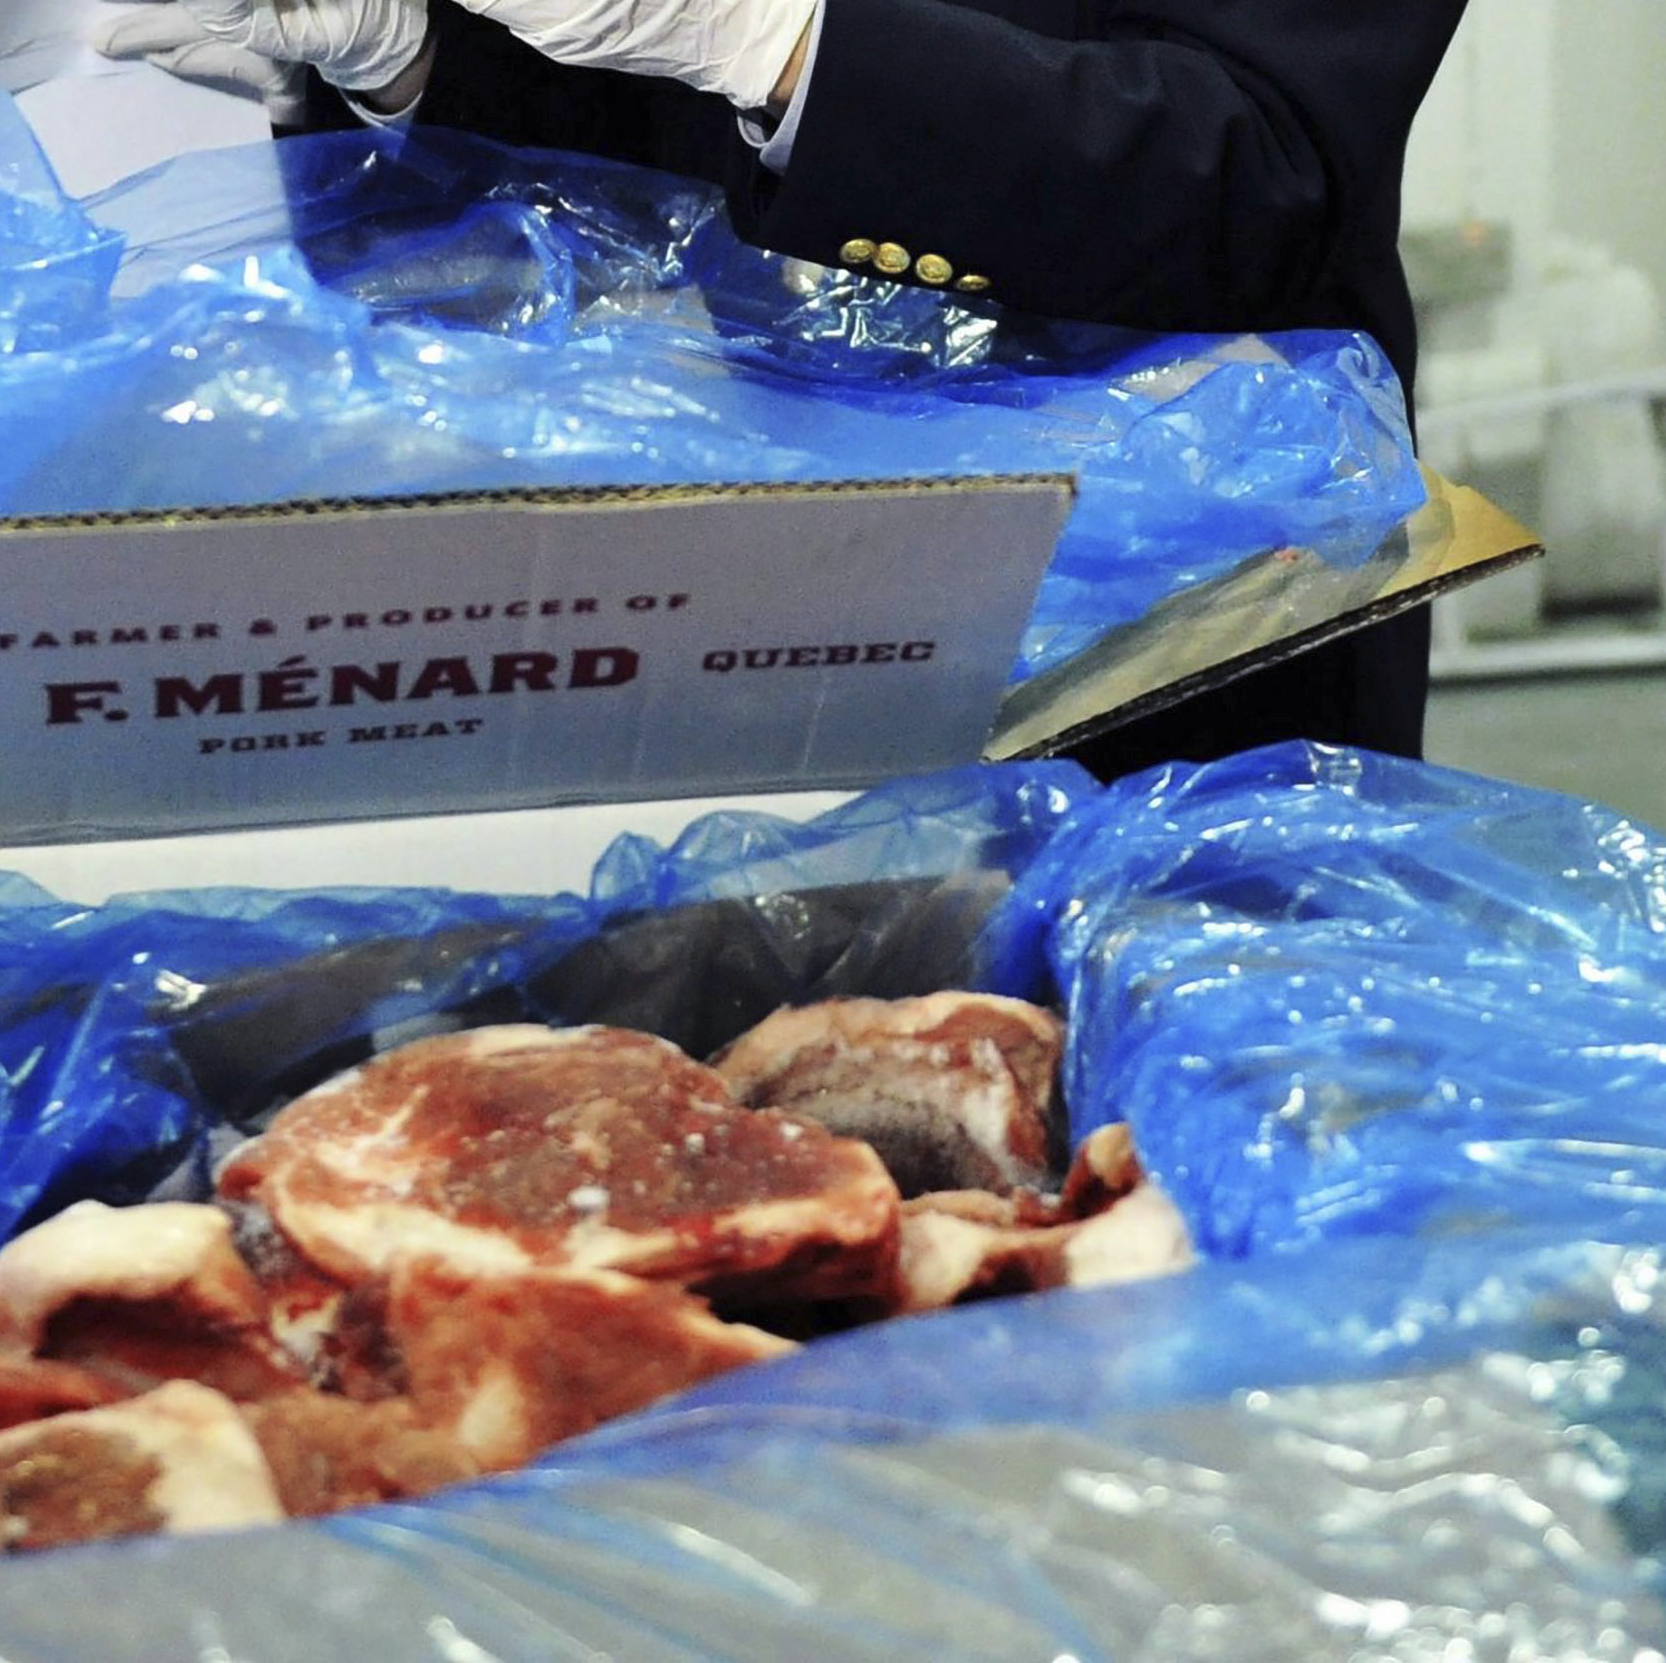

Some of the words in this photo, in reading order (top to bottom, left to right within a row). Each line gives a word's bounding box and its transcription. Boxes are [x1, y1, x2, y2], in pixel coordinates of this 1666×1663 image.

[248, 618, 277, 636] &
[305, 596, 600, 633] PRODUCER
[626, 592, 692, 613] OF
[701, 641, 936, 674] QUEBEC
[198, 729, 327, 755] PORK
[347, 718, 485, 745] MEAT
